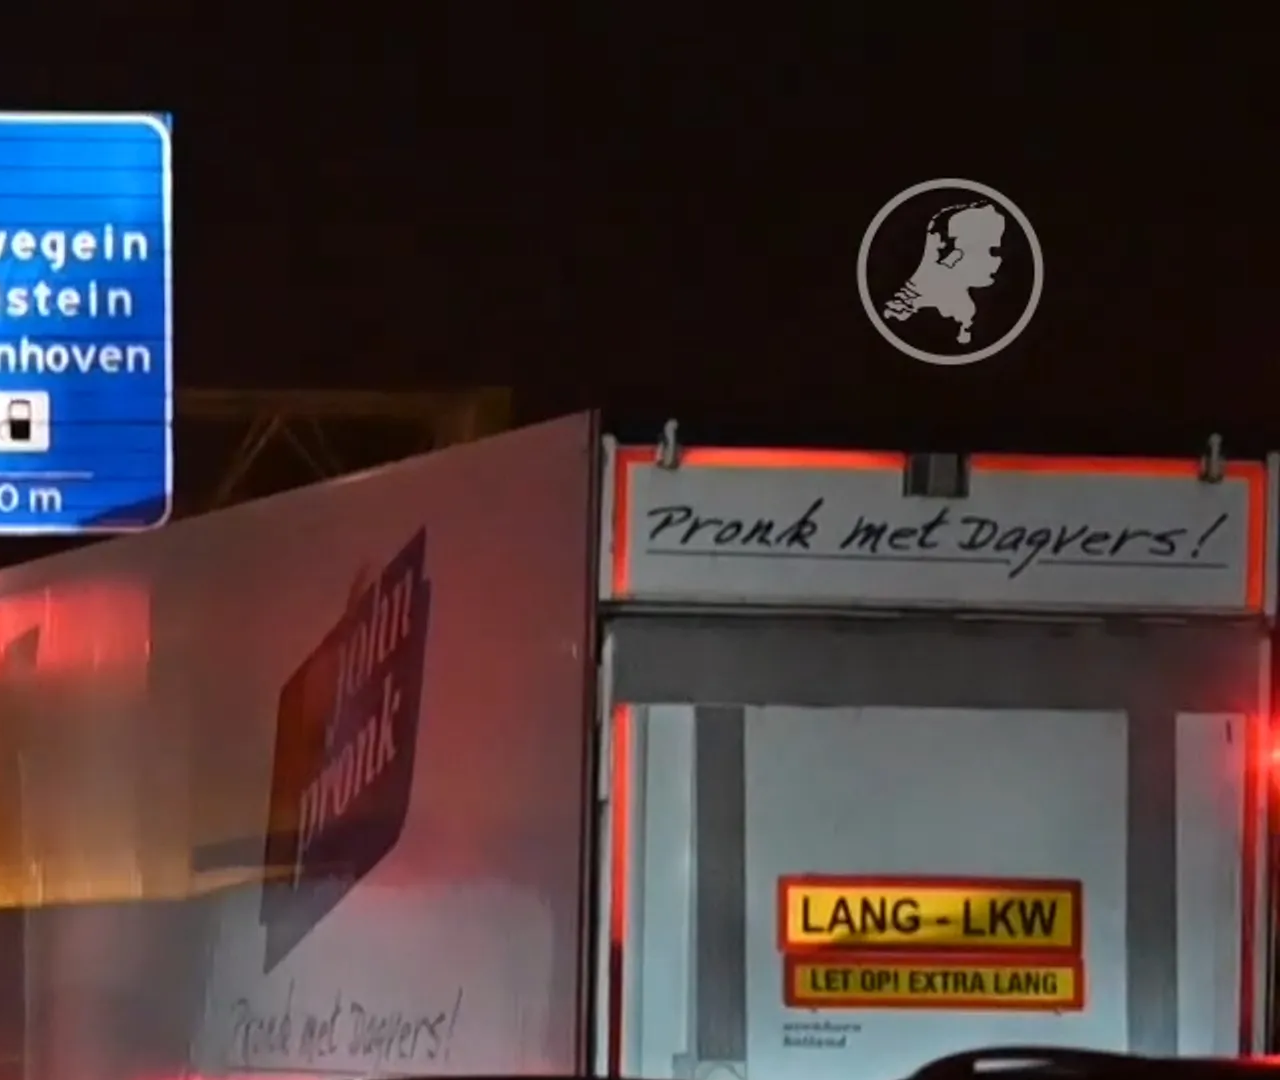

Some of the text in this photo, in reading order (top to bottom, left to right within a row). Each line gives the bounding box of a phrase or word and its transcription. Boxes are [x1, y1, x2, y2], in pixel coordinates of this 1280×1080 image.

[28, 486, 63, 512] m
[646, 496, 1230, 579] Pronk met Dagvers!
[292, 670, 401, 895] pronk
[801, 893, 922, 935] LANG
[963, 897, 1058, 938] LKW
[809, 967, 1058, 996] LET OP! EXTRA LANG
